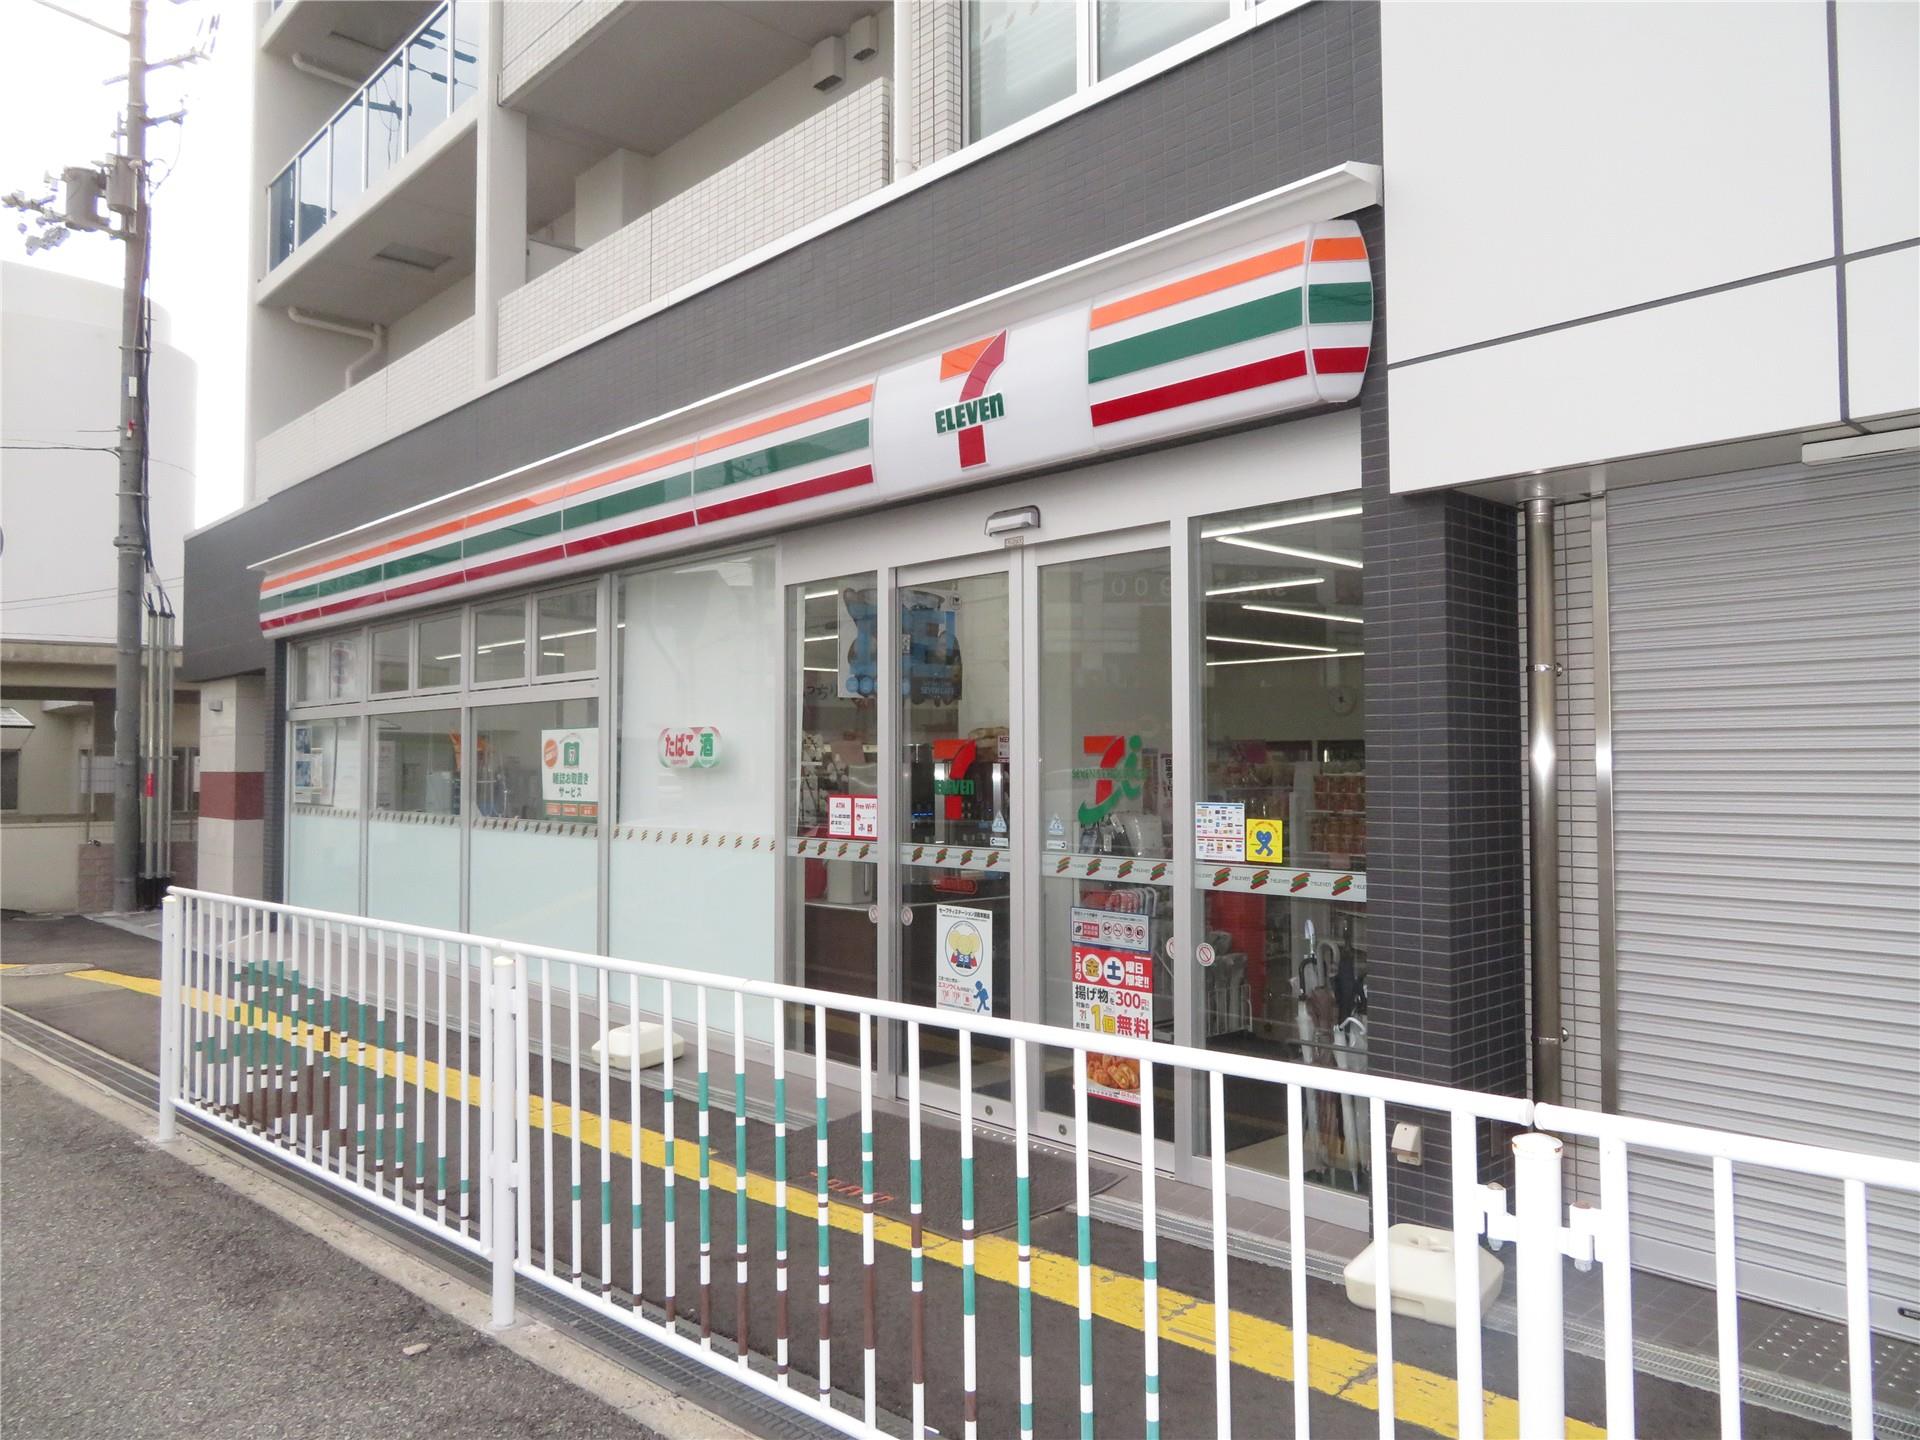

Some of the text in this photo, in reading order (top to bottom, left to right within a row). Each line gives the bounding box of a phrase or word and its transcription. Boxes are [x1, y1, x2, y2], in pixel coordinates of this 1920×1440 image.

[940, 328, 1007, 468] 7
[664, 733, 713, 757] たばこ 酒
[559, 787, 582, 798] サービス
[1085, 958, 1122, 980] 金 土
